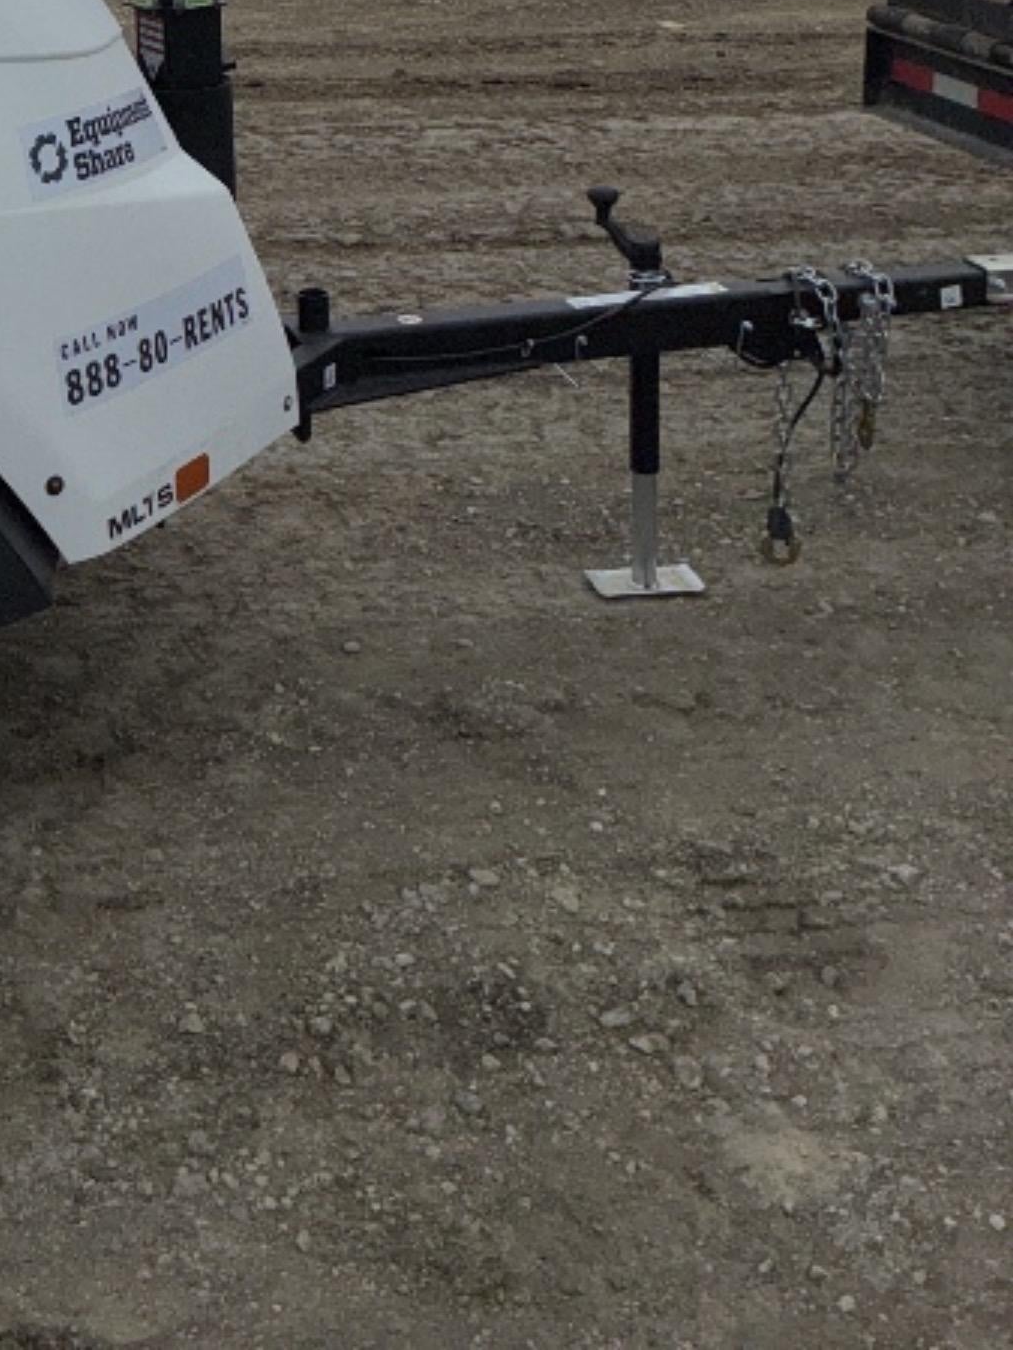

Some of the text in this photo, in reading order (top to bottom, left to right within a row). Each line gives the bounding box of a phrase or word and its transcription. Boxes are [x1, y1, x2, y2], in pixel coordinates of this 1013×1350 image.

[73, 140, 136, 181] Share
[60, 313, 139, 361] CALL NOW
[64, 286, 250, 406] 888-80-RENTS
